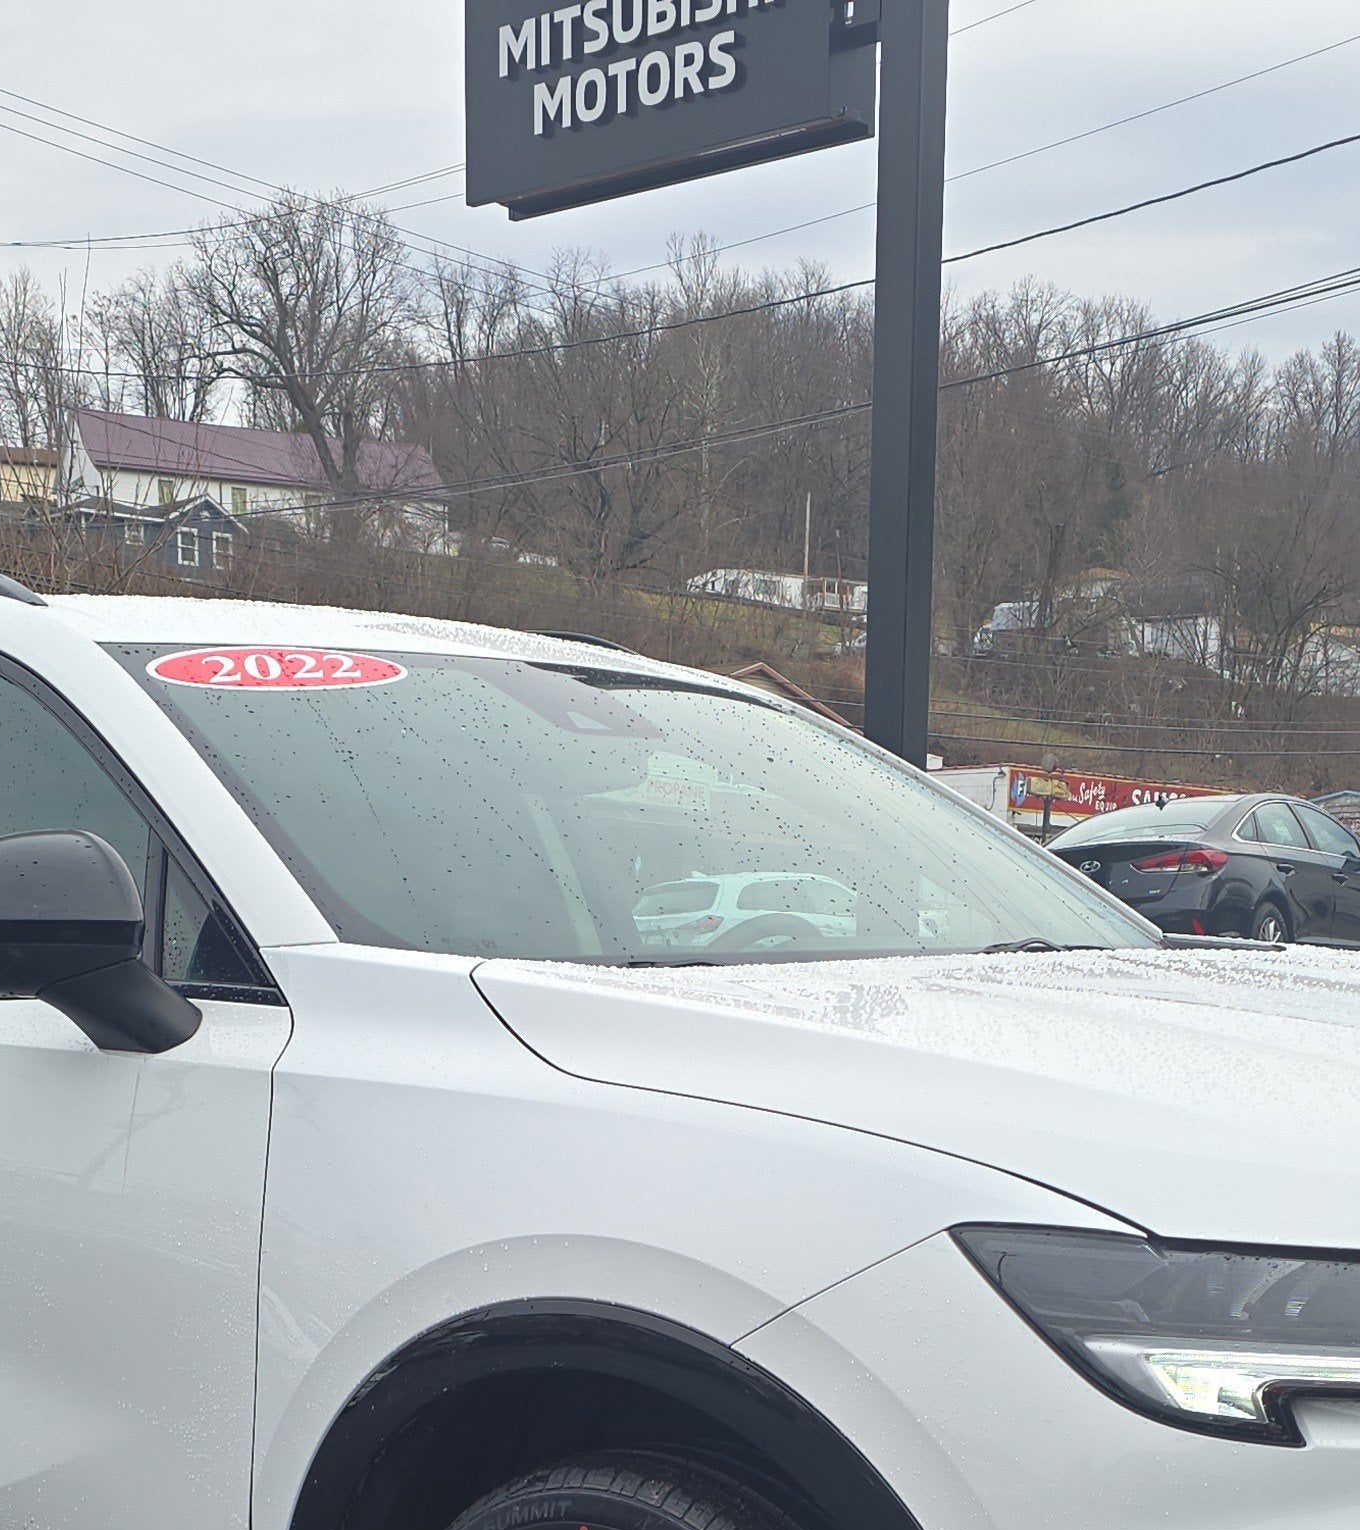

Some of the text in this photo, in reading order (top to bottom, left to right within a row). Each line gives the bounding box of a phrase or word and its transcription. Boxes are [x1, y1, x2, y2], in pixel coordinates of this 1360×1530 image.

[499, 0, 775, 77] MITSUBI
[533, 30, 736, 135] MOTORS
[201, 653, 362, 684] 2022
